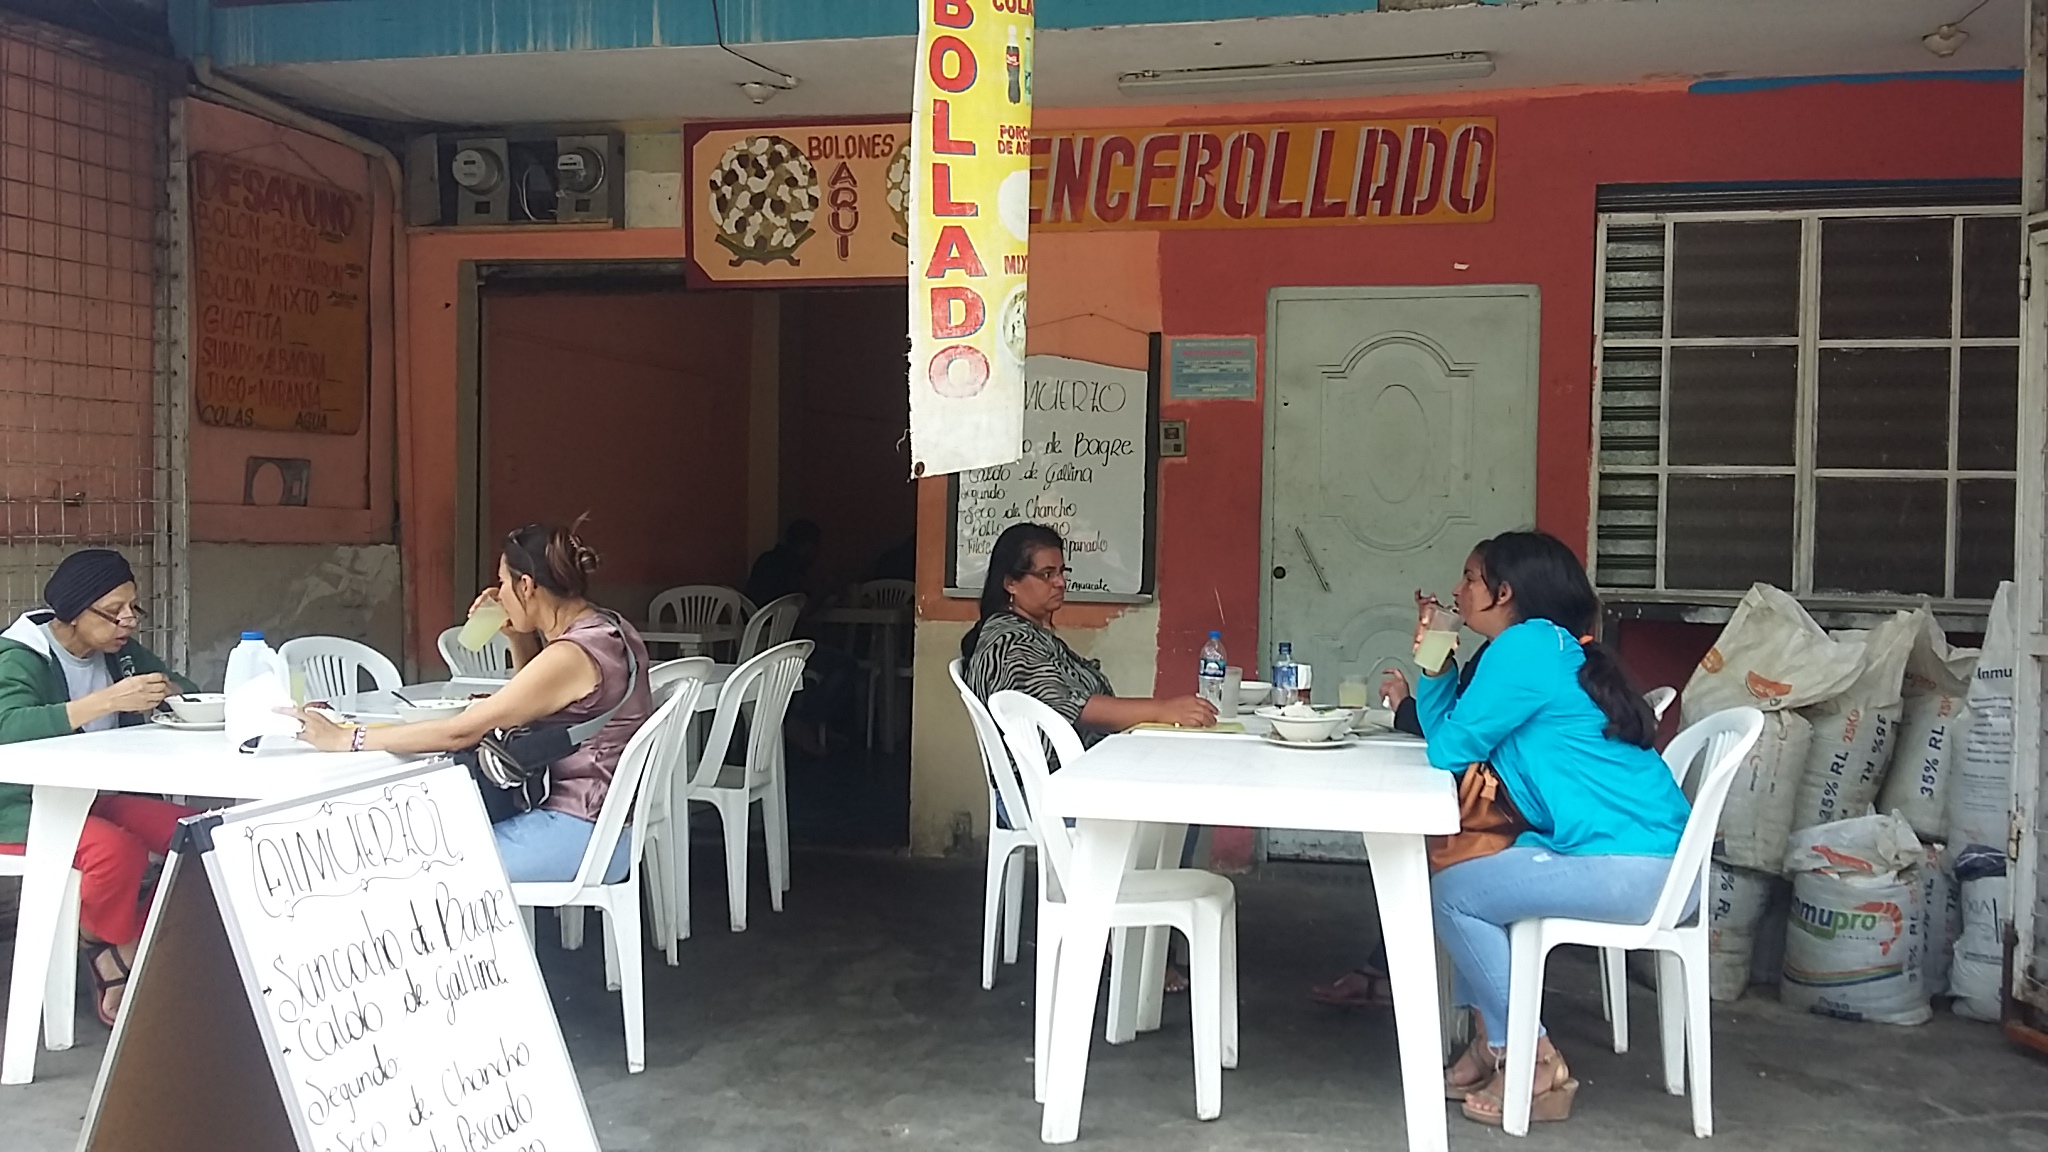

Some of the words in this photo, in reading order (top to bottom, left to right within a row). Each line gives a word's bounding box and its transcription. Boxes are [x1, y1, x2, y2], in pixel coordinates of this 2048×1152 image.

[808, 133, 895, 161] BOLONES
[998, 139, 1013, 155] DE
[197, 201, 260, 242] BOLON
[828, 161, 860, 261] AQUI
[199, 237, 260, 276] BOLON
[200, 270, 257, 308] BOLON
[1024, 380, 1126, 412] MUERZO
[202, 404, 254, 427] COLAS
[295, 411, 328, 431] AGUA
[1043, 431, 1062, 455] de
[1018, 461, 1038, 480] de
[1043, 462, 1093, 491] Gallina
[1025, 495, 1077, 518] Chancho
[1929, 725, 1945, 751] RL
[1830, 751, 1849, 775] RL
[1920, 758, 1939, 798] 35%
[273, 910, 403, 1023] Sancocho
[298, 990, 383, 1062] Caldo
[403, 968, 429, 1017] de
[436, 954, 510, 1026] Gallina
[408, 1083, 434, 1127] de
[441, 1037, 530, 1107] Chancho
[456, 1080, 533, 1152] Pescado
